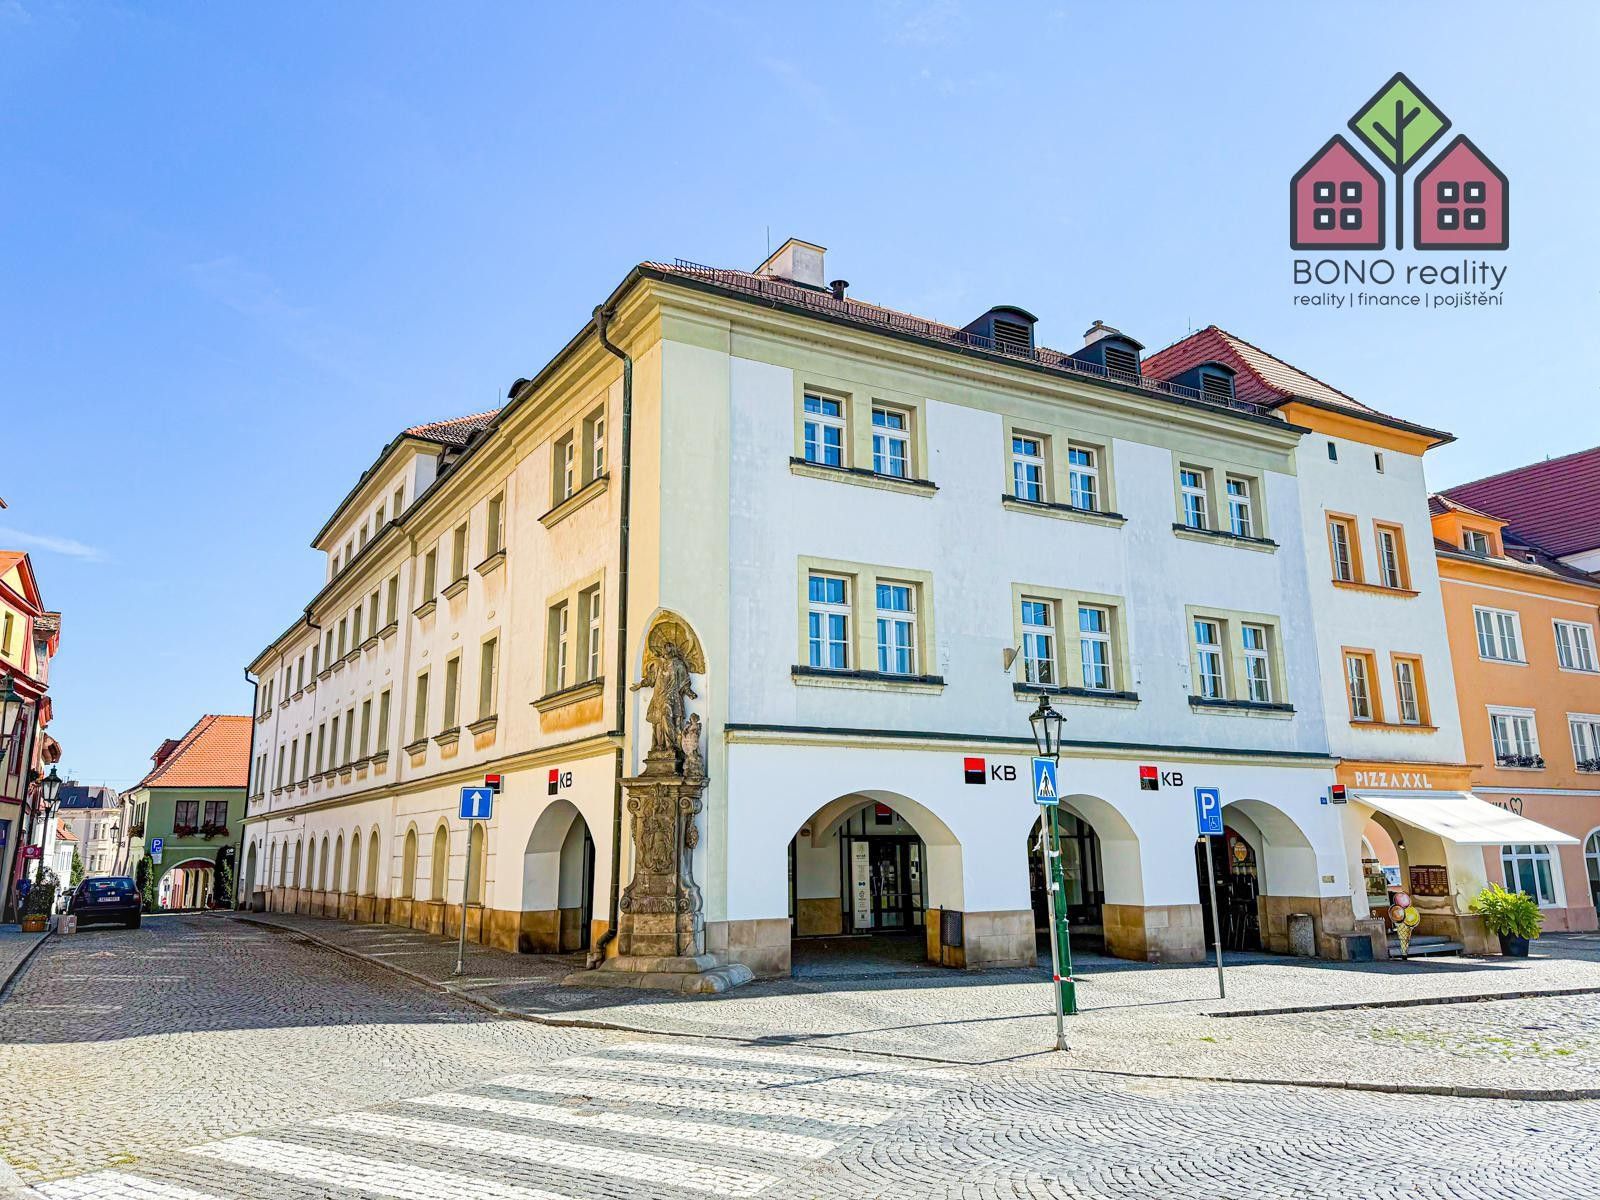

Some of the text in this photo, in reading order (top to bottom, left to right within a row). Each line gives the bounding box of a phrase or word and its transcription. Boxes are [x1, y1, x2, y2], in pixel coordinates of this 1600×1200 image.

[560, 771, 572, 788] KB
[991, 765, 1016, 781] KB
[1161, 771, 1184, 787] KB
[1200, 793, 1215, 819] P
